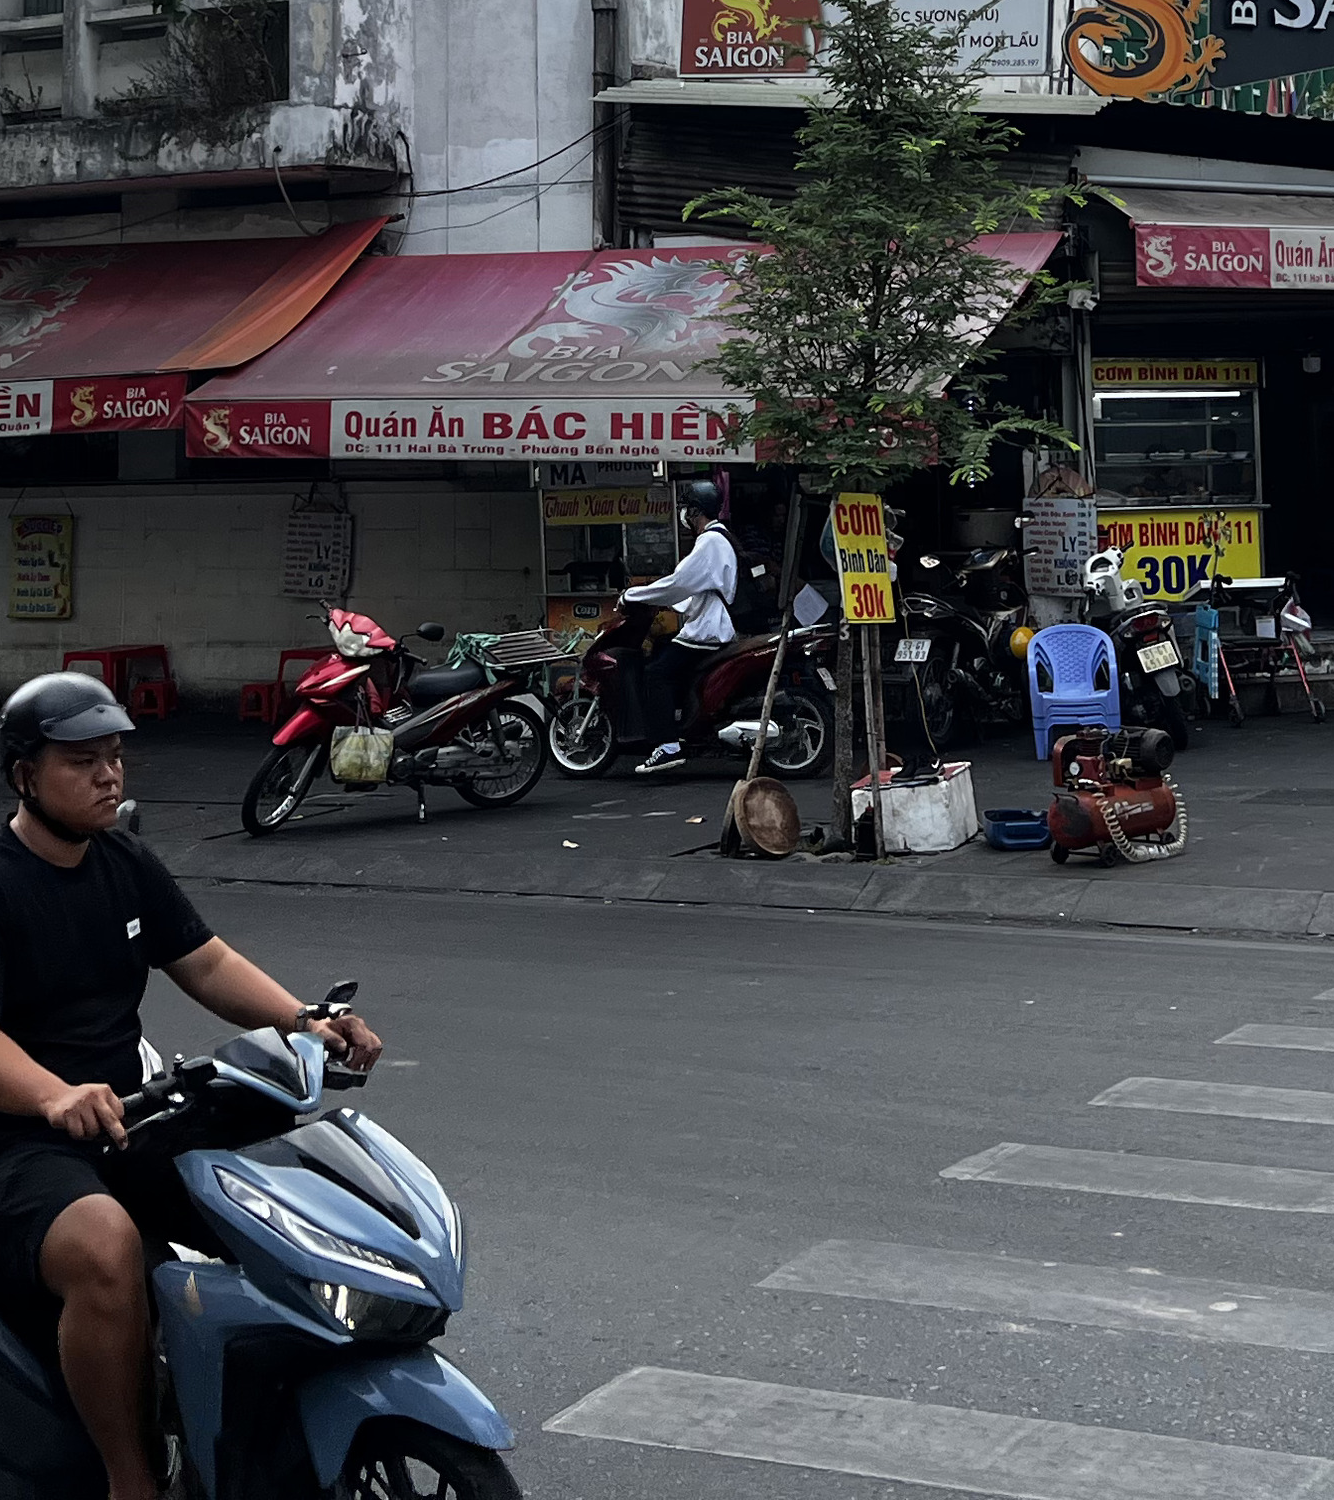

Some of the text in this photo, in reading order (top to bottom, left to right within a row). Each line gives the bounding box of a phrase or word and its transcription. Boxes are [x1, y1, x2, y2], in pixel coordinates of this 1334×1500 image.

[726, 32, 753, 44] BIA
[695, 46, 784, 67] SAIGON
[1212, 242, 1236, 252] BIA
[1275, 240, 1313, 269] Quán
[1185, 254, 1263, 272] SAIGON
[542, 345, 622, 360] BIA
[420, 361, 697, 383] SAIGON
[1094, 364, 1251, 381] CƠM BÌNH DÂN 111
[126, 387, 146, 399] BIA
[102, 398, 170, 419] SAIGON
[264, 413, 287, 425] BIA
[345, 401, 740, 440] Quán Ăn BÁC HIỀN
[239, 426, 311, 445] SAIGON
[376, 444, 402, 453] 111
[408, 444, 431, 453] Hai
[437, 443, 457, 453] Bà
[462, 444, 504, 455] Trưng
[1139, 517, 1179, 546] BÌNH
[317, 545, 331, 559] LY
[1062, 536, 1077, 552] LY
[840, 548, 887, 573] Bình Dân
[1137, 555, 1212, 596] 30K
[575, 603, 597, 616] Cozy
